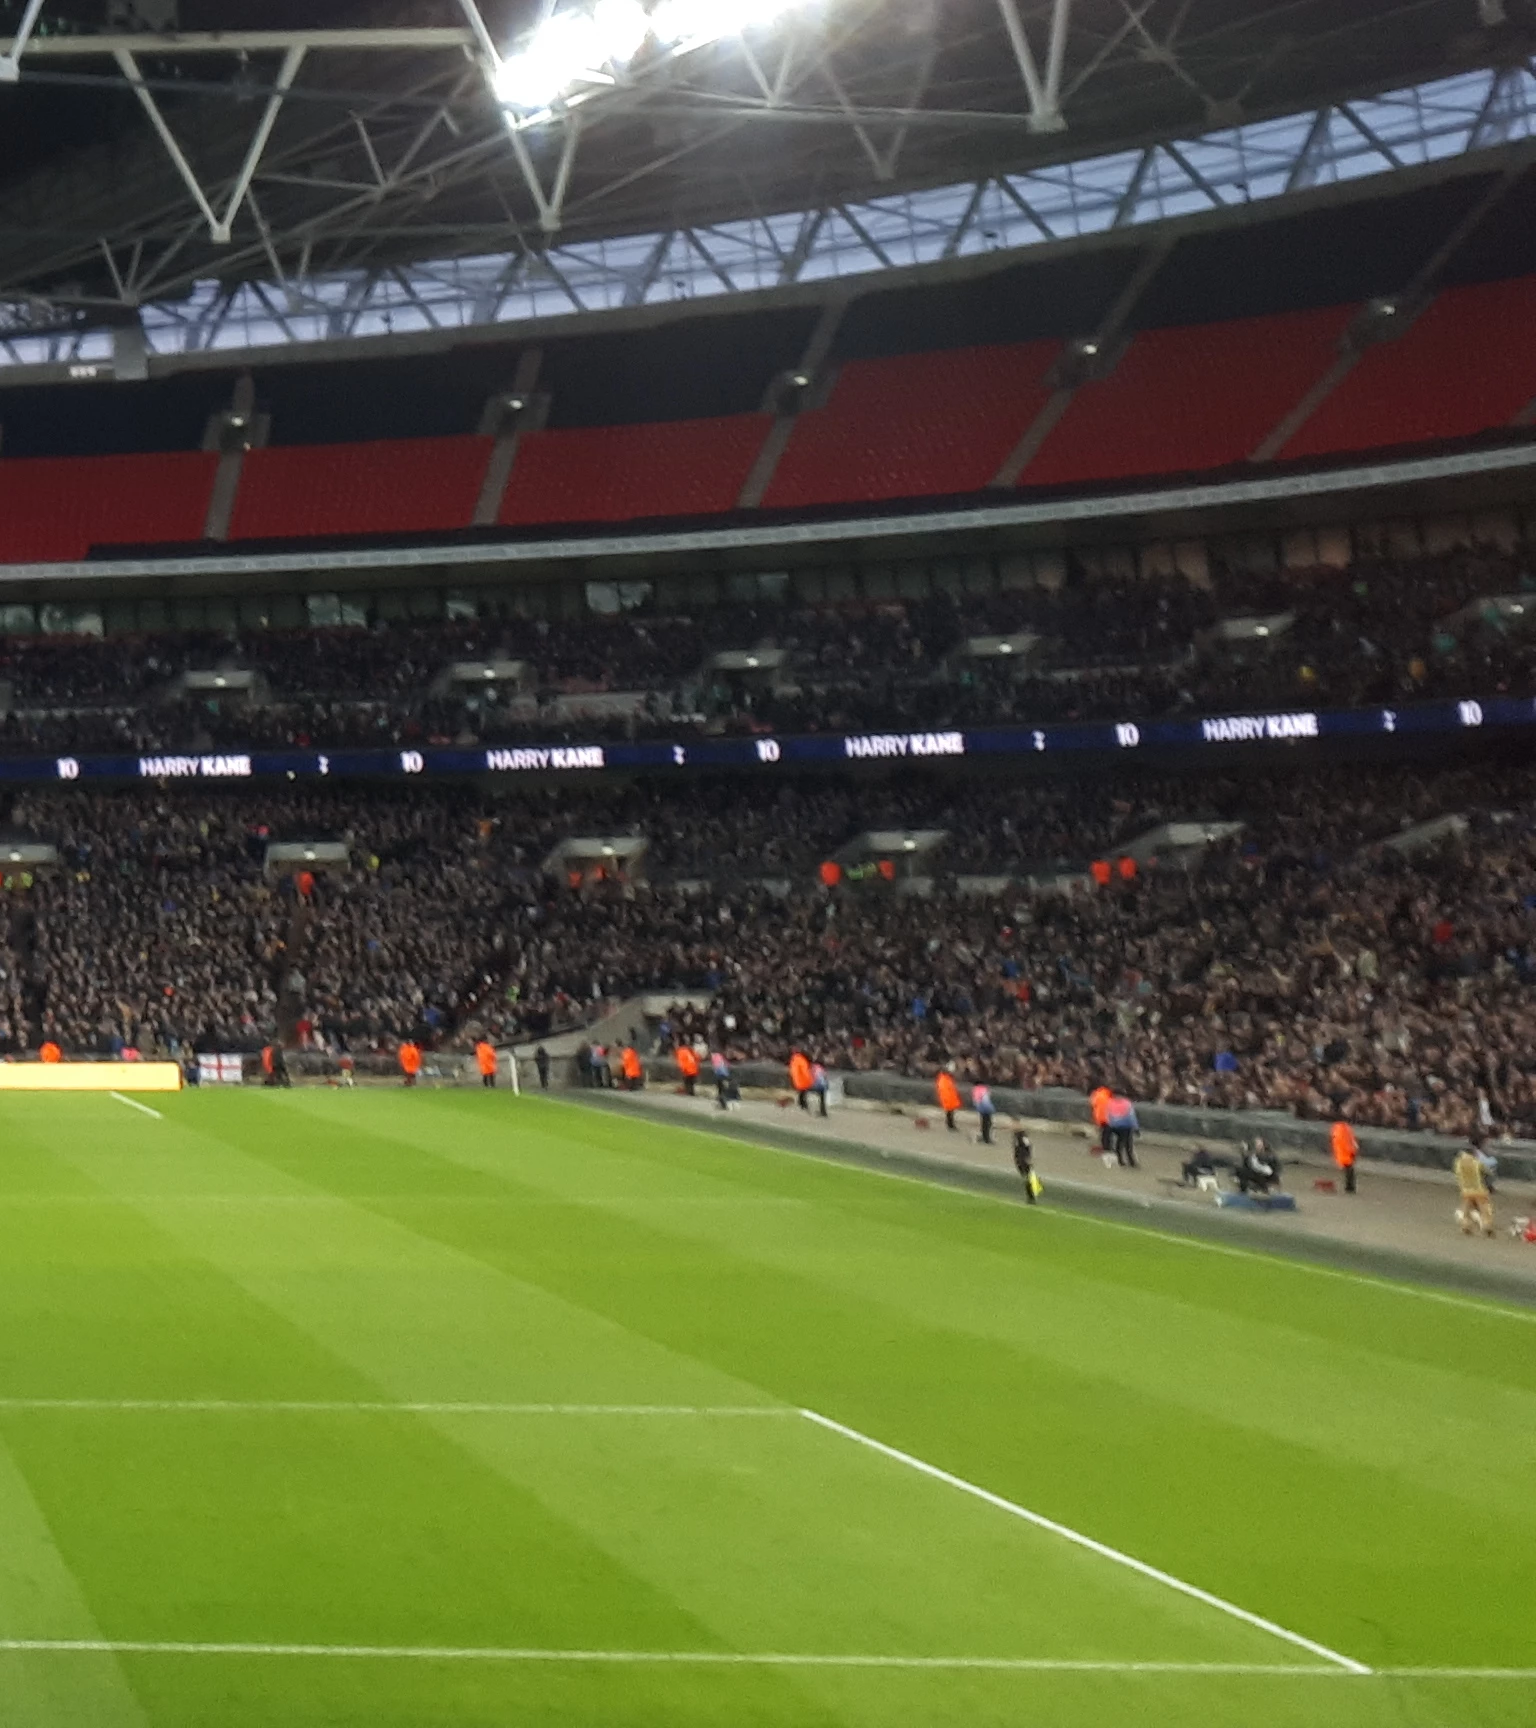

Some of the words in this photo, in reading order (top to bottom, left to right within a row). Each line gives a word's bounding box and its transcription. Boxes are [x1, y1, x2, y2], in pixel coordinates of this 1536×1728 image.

[1459, 701, 1482, 725] 10
[1116, 723, 1139, 746] 10
[1203, 717, 1265, 740] HARRY
[1266, 713, 1318, 738] KANE
[757, 739, 779, 761] 10
[845, 735, 908, 757] HARRY
[909, 732, 964, 754] KANE
[57, 758, 79, 779] 10
[140, 757, 199, 776] HARRY
[201, 755, 251, 776] KANE
[401, 751, 423, 772] 10
[487, 749, 549, 769] HARRY
[549, 747, 604, 768] KANE
